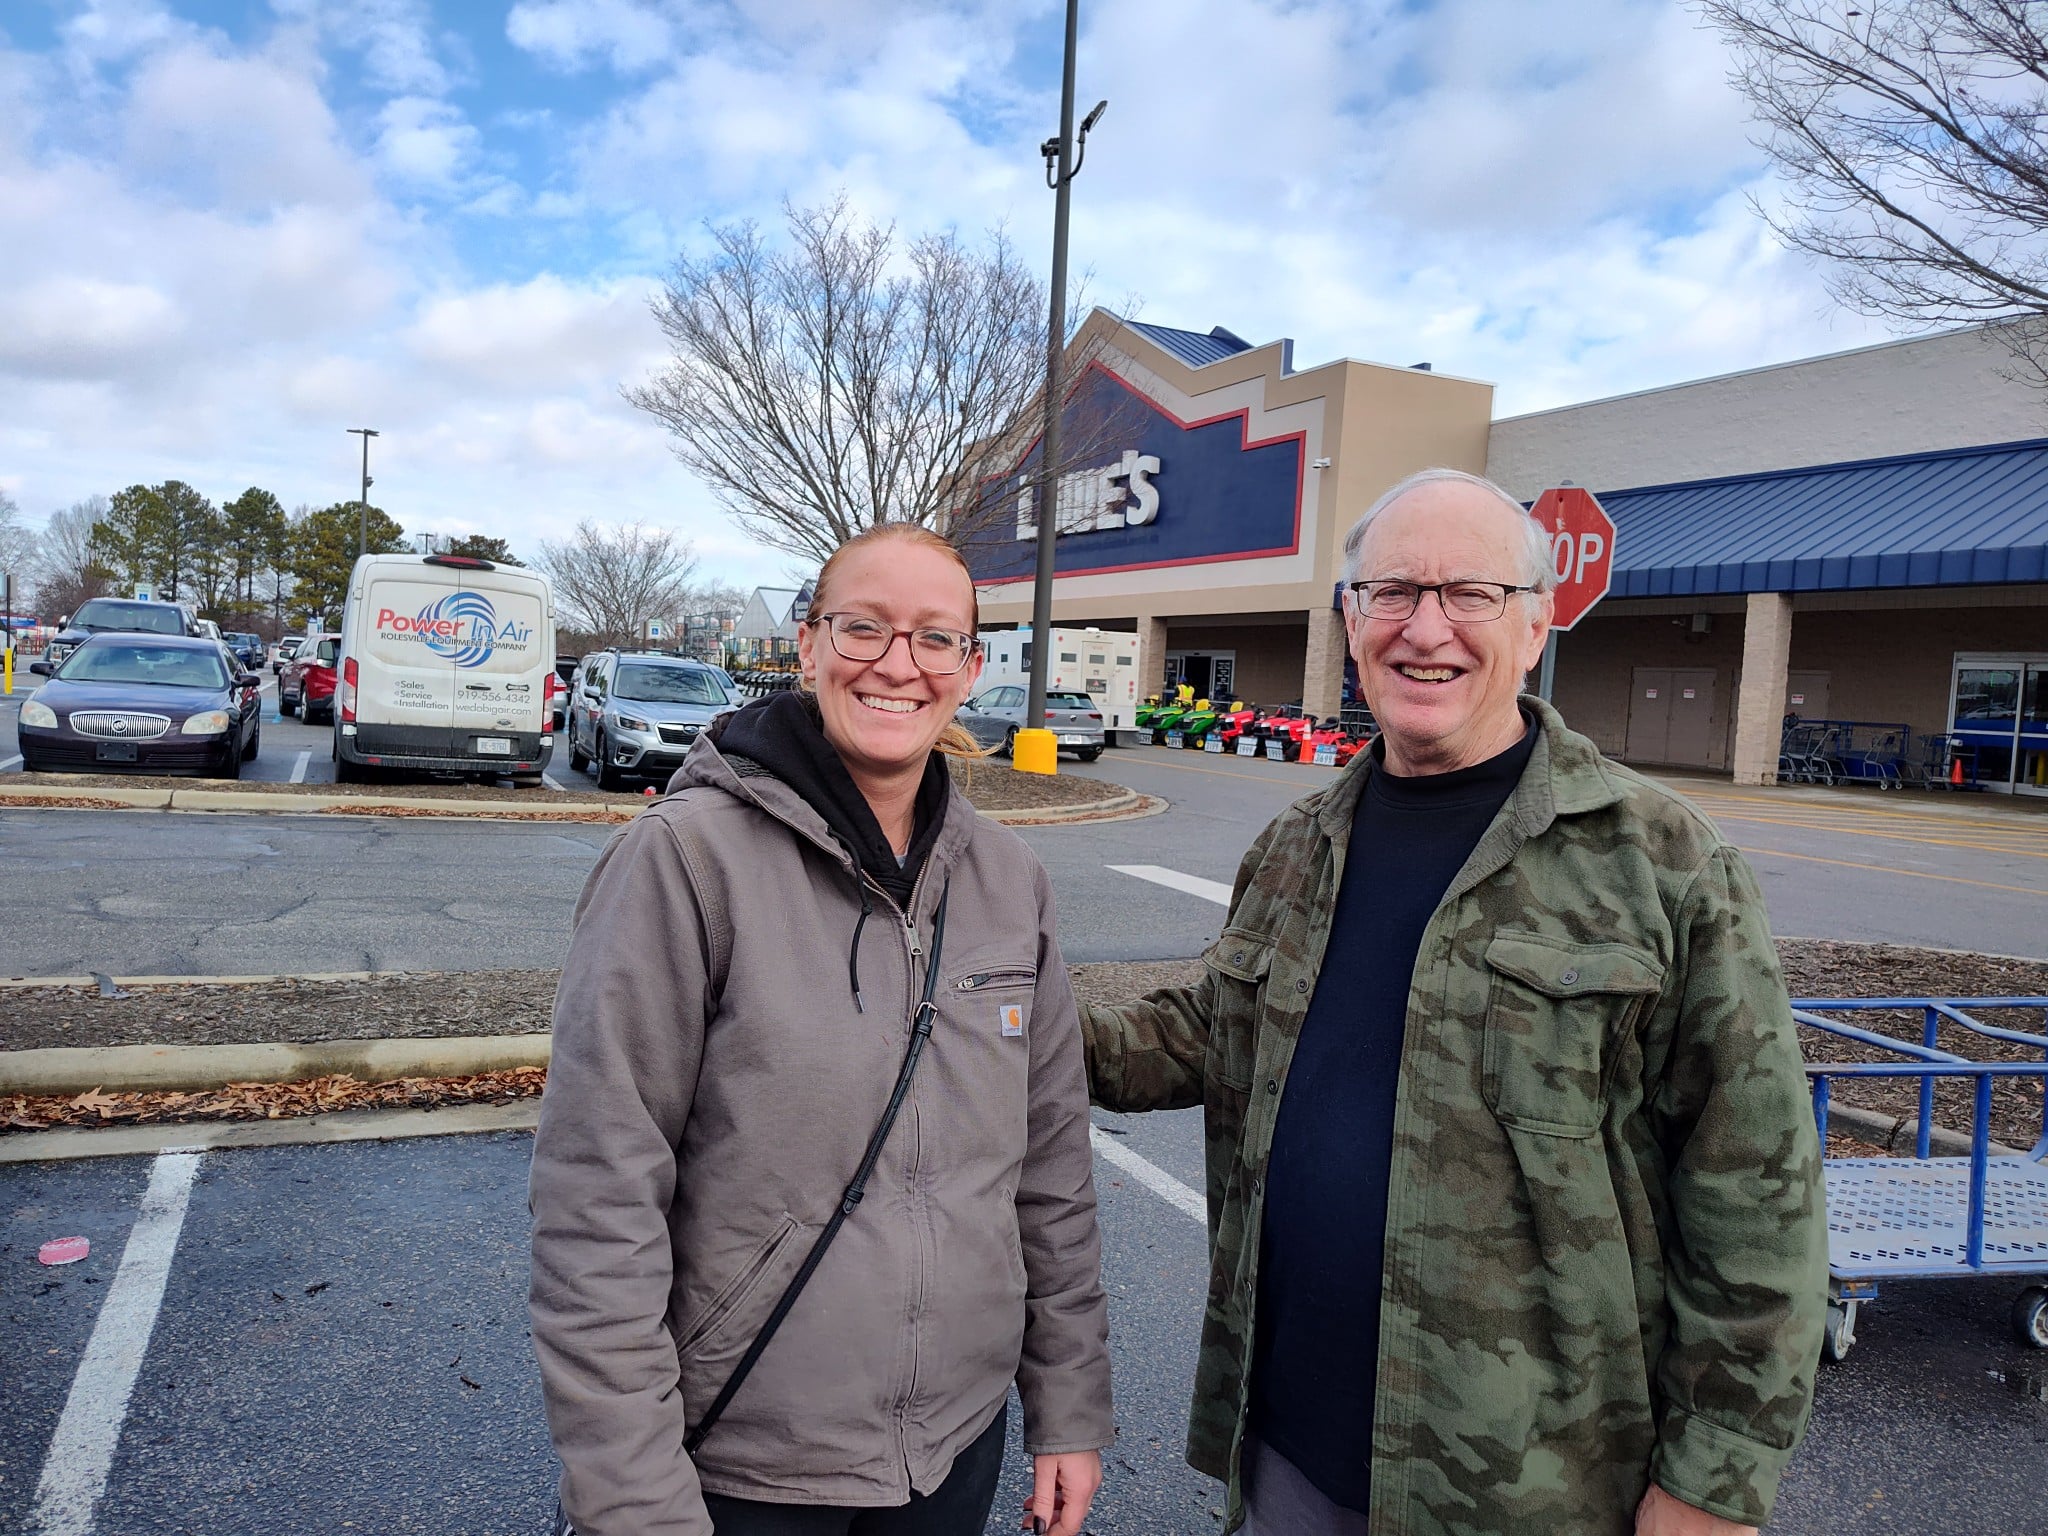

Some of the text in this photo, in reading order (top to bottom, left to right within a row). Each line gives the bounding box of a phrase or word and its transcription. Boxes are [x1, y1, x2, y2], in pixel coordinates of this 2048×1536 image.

[1016, 450, 1160, 540] LWE'S
[1546, 532, 1604, 584] OP
[376, 608, 533, 642] Power In Air
[380, 632, 527, 651] ROLESVILLE EQUIPMENT COMPANY
[400, 680, 424, 690] Sales
[400, 690, 432, 700] Service
[457, 690, 531, 704] 919-556-4342
[399, 700, 449, 710] Installation
[455, 703, 532, 716] wedobigair.com
[1315, 752, 1333, 763] 3699
